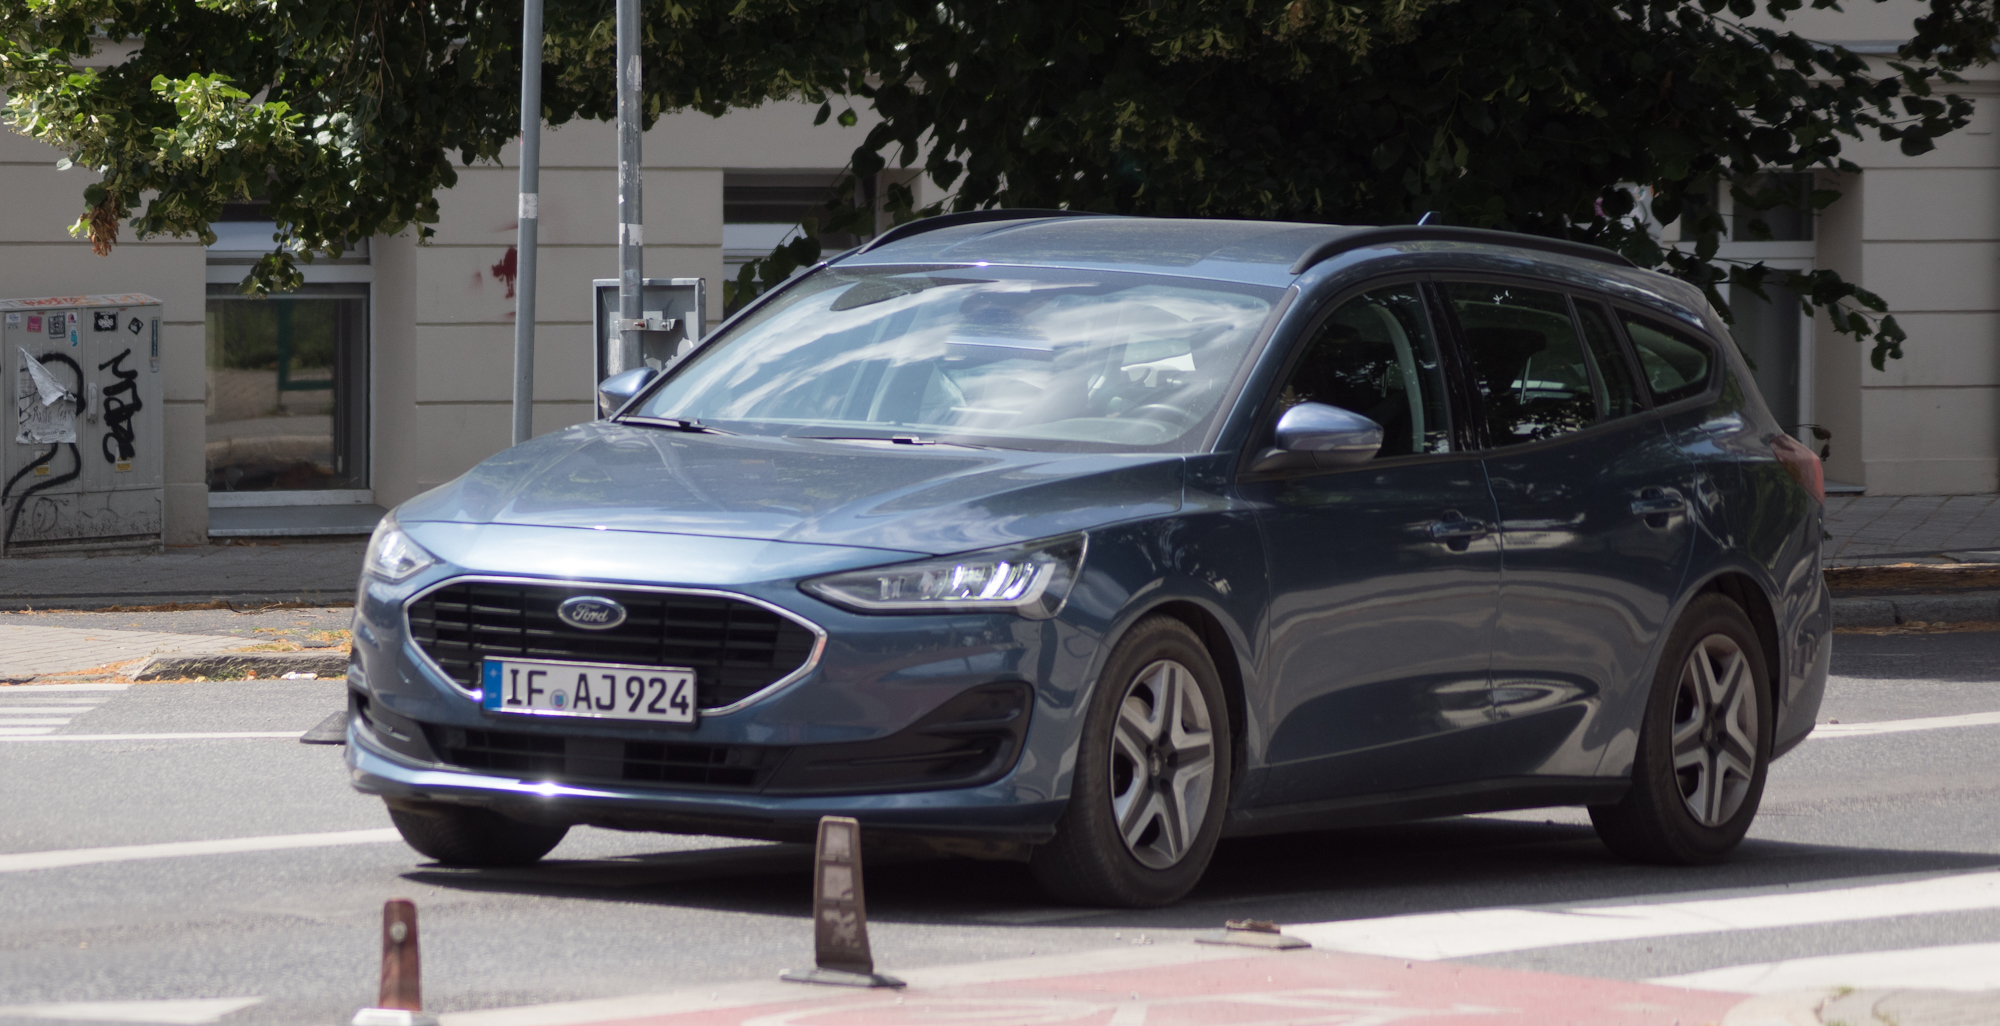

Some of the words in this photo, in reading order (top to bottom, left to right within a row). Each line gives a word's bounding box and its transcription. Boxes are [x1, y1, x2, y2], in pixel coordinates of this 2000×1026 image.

[572, 603, 609, 622] Ford
[507, 669, 547, 706] IF
[573, 673, 616, 711] AJ
[625, 675, 690, 716] 924
